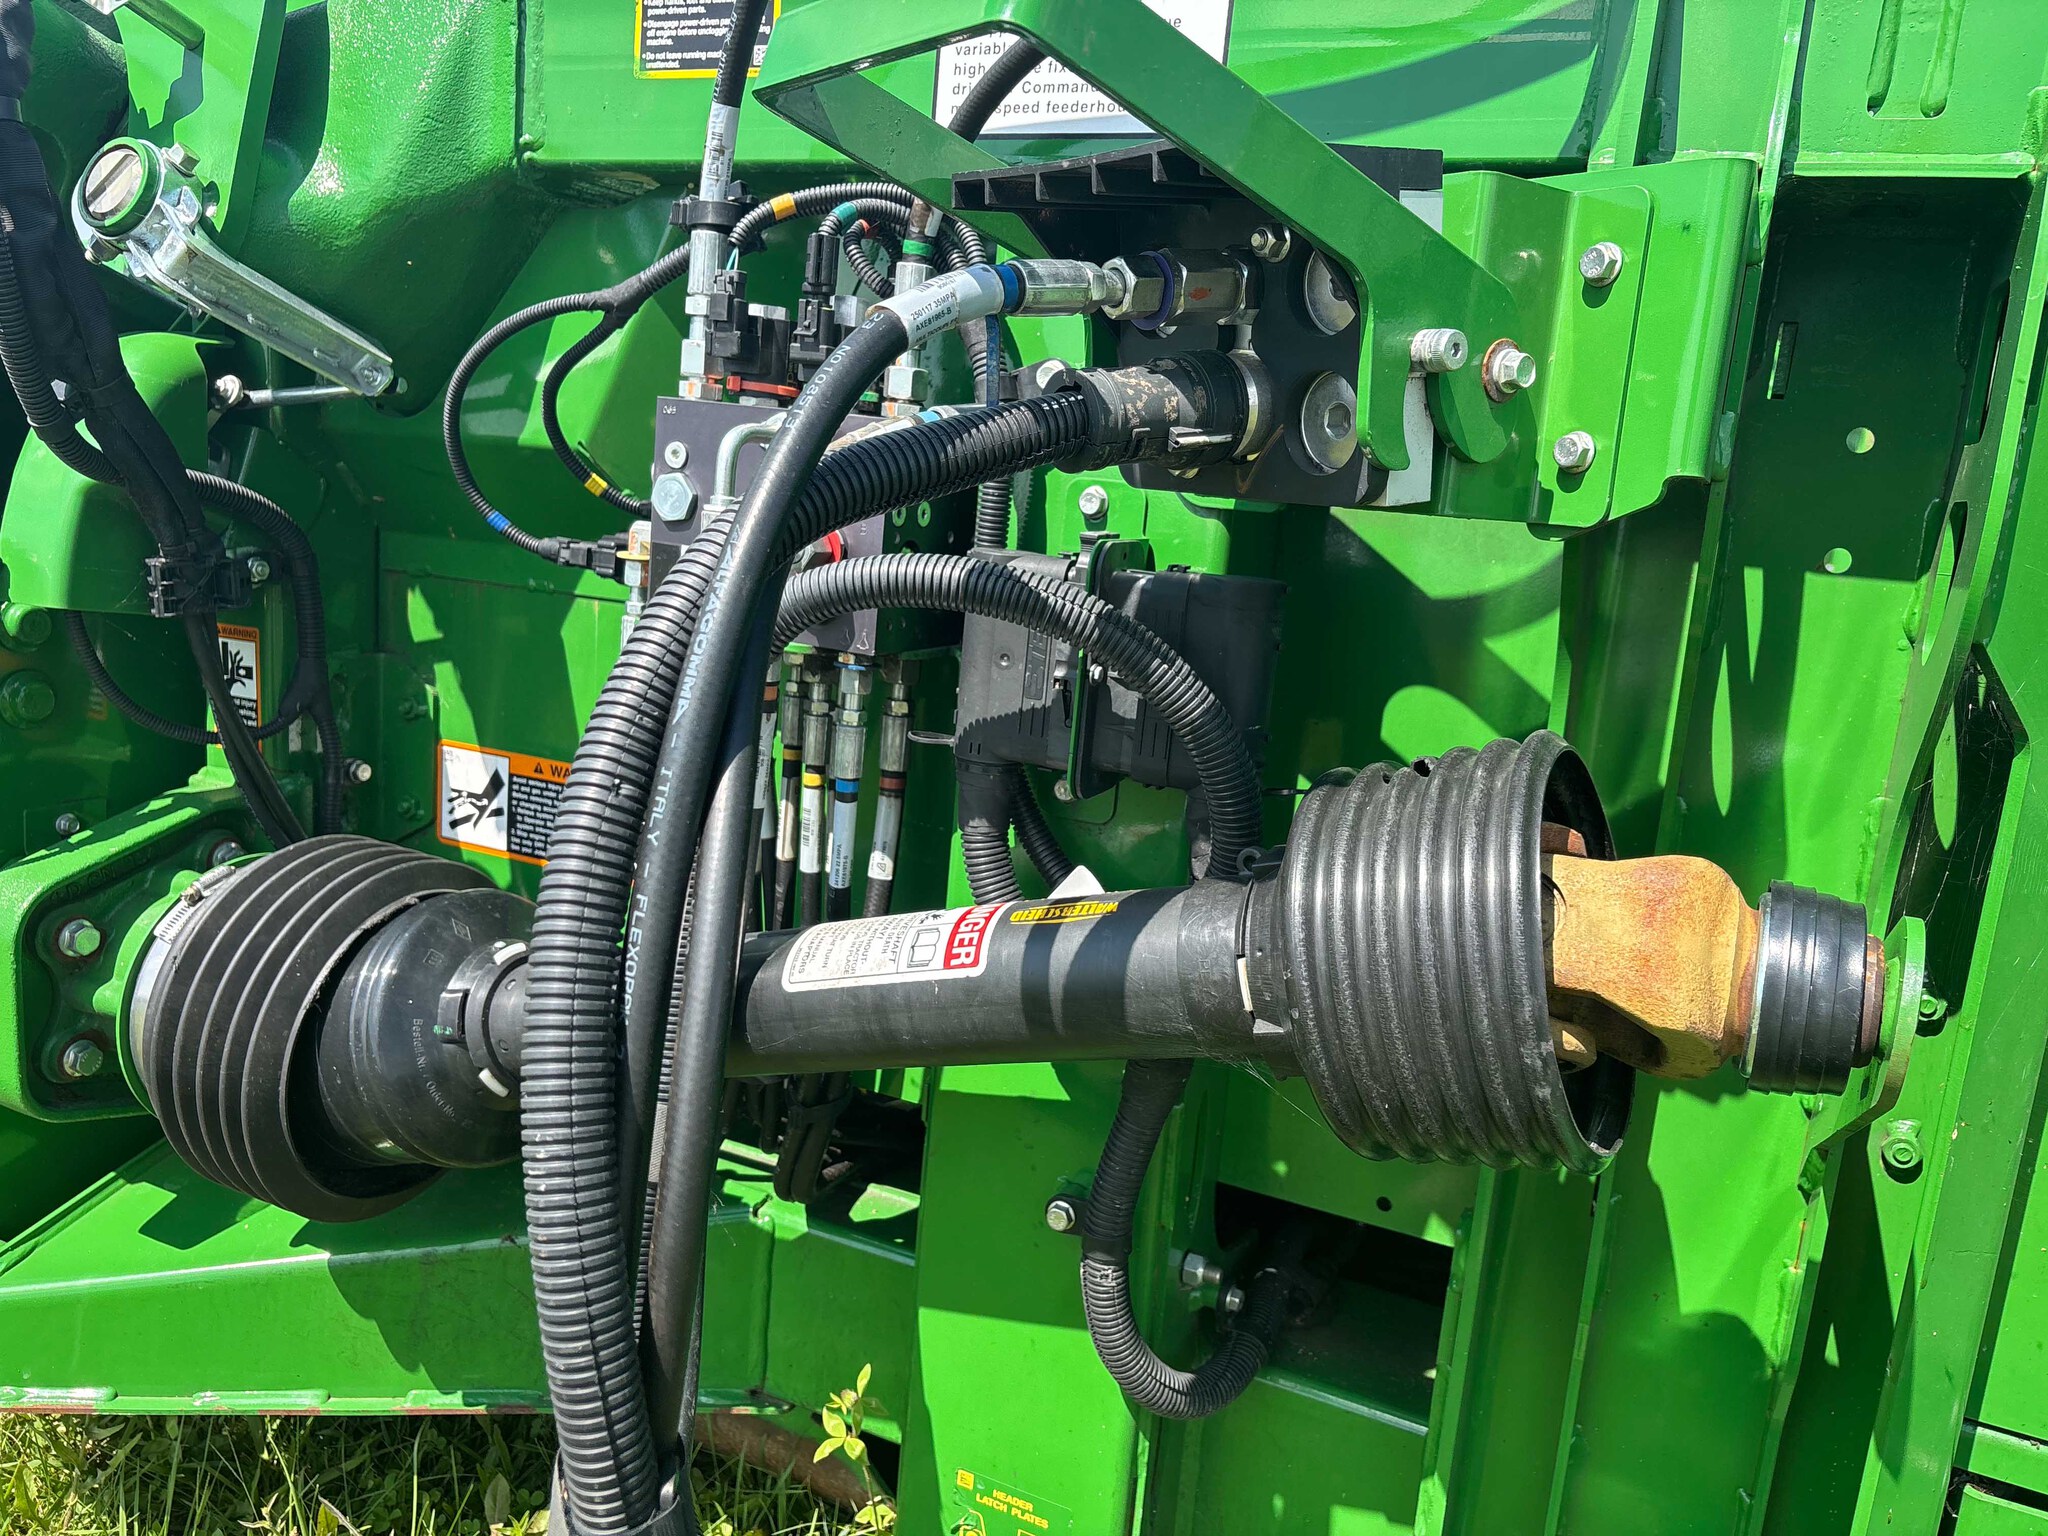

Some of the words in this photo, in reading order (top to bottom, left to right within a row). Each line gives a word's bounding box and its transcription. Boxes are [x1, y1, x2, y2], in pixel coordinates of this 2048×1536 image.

[647, 6, 687, 17] power-driven
[688, 6, 707, 15] parts.
[647, 19, 679, 29] Disengage
[680, 18, 719, 28] power-driven
[720, 18, 731, 27] par
[646, 29, 656, 37] off
[656, 29, 677, 38] engine
[677, 27, 697, 36] before
[646, 38, 674, 46] machine.
[645, 52, 655, 60] Do
[655, 51, 666, 60] not
[666, 51, 682, 60] leave
[682, 50, 707, 61] running
[956, 43, 1009, 56] variabl
[1048, 60, 1066, 73] fix
[1046, 99, 1127, 114] feederhou
[220, 626, 258, 639] WARNING
[647, 766, 673, 846] ITALY
[1009, 901, 1119, 922] WALTERSCHEID
[950, 902, 1004, 967] NGER
[623, 893, 649, 1027] FLEXOPA
[992, 1489, 1034, 1512] HEADER
[976, 1493, 1008, 1513] LATCH
[1010, 1507, 1049, 1530] PLATES
